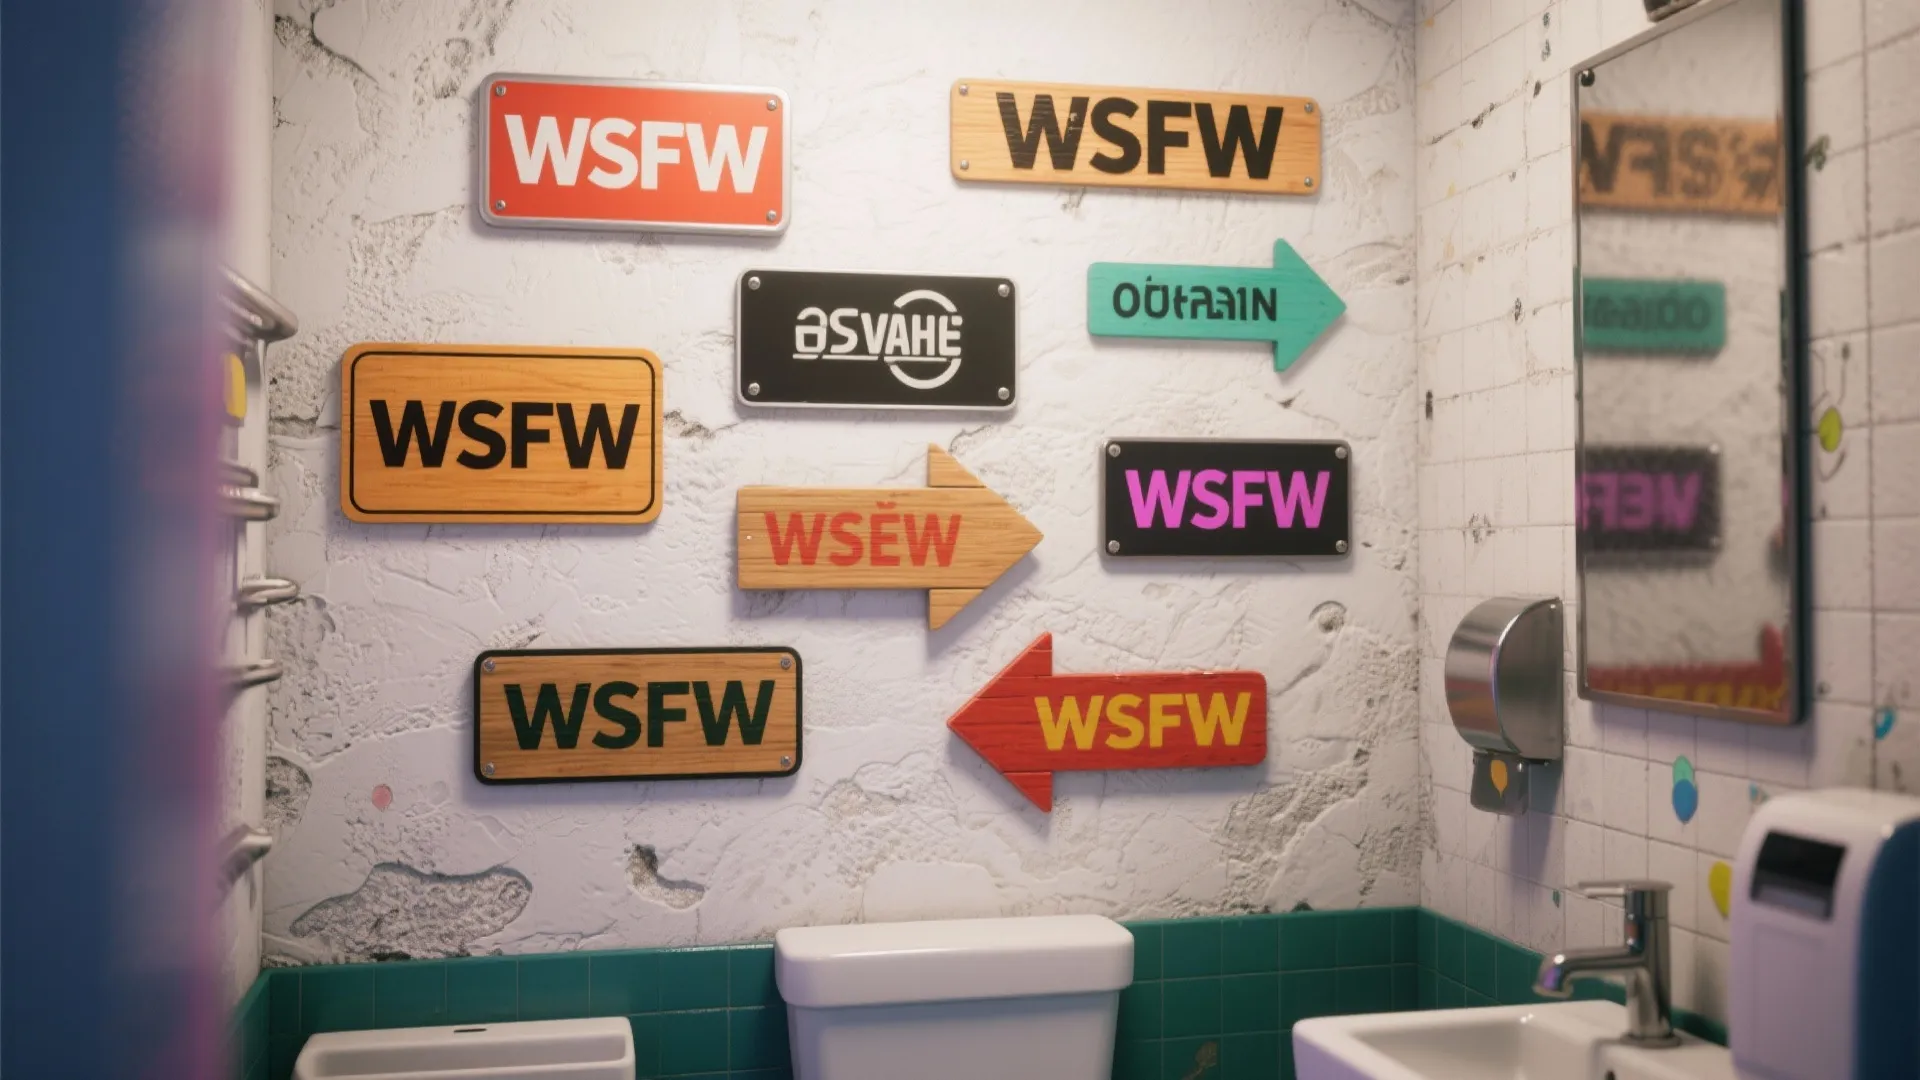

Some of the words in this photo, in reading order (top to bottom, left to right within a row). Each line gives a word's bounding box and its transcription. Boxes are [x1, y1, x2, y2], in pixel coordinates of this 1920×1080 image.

[505, 114, 769, 193] WSFW
[996, 92, 1284, 180] WSFW
[369, 399, 640, 470] WSFW
[1125, 469, 1330, 530] WSFW
[504, 679, 776, 752] WSFW
[1034, 691, 1251, 751] WSFW
